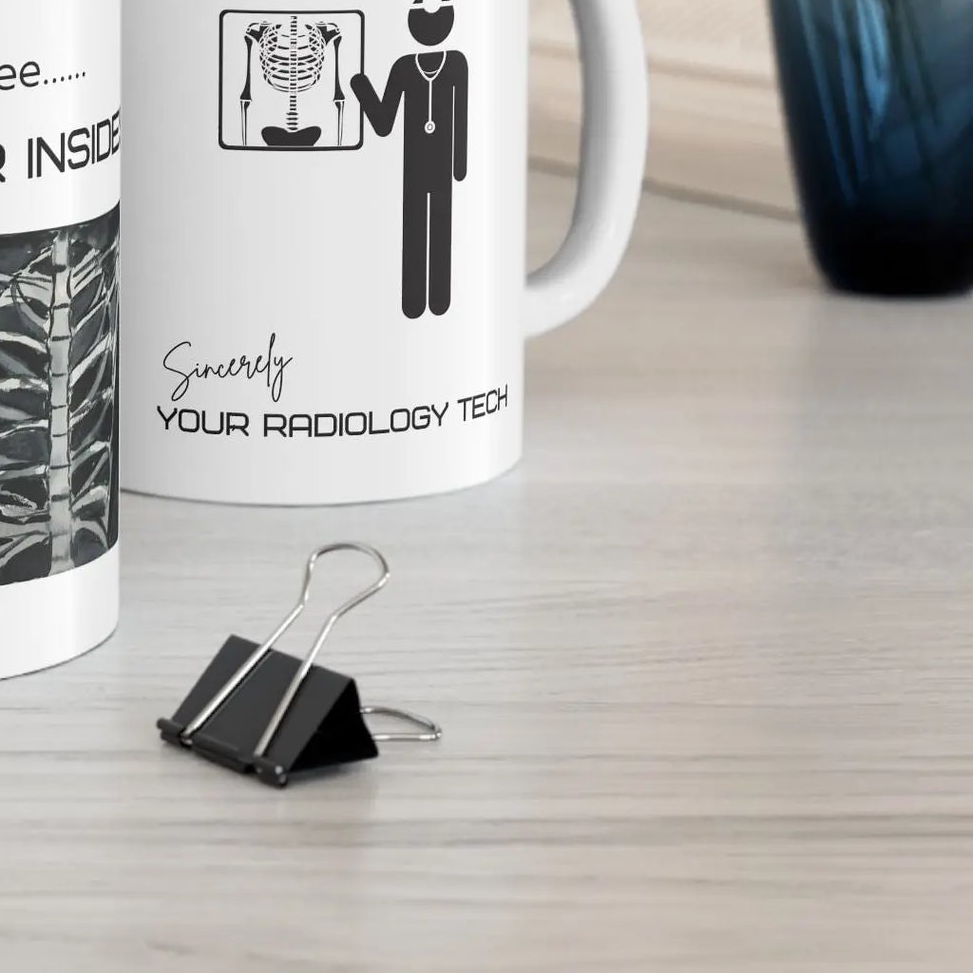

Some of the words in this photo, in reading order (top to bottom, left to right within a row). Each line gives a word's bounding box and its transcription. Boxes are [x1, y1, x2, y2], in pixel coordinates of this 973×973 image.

[163, 332, 293, 402] Sincerely
[157, 405, 249, 437] YOUR
[263, 401, 449, 438] RADIOLOGY
[457, 384, 508, 422] TECH
